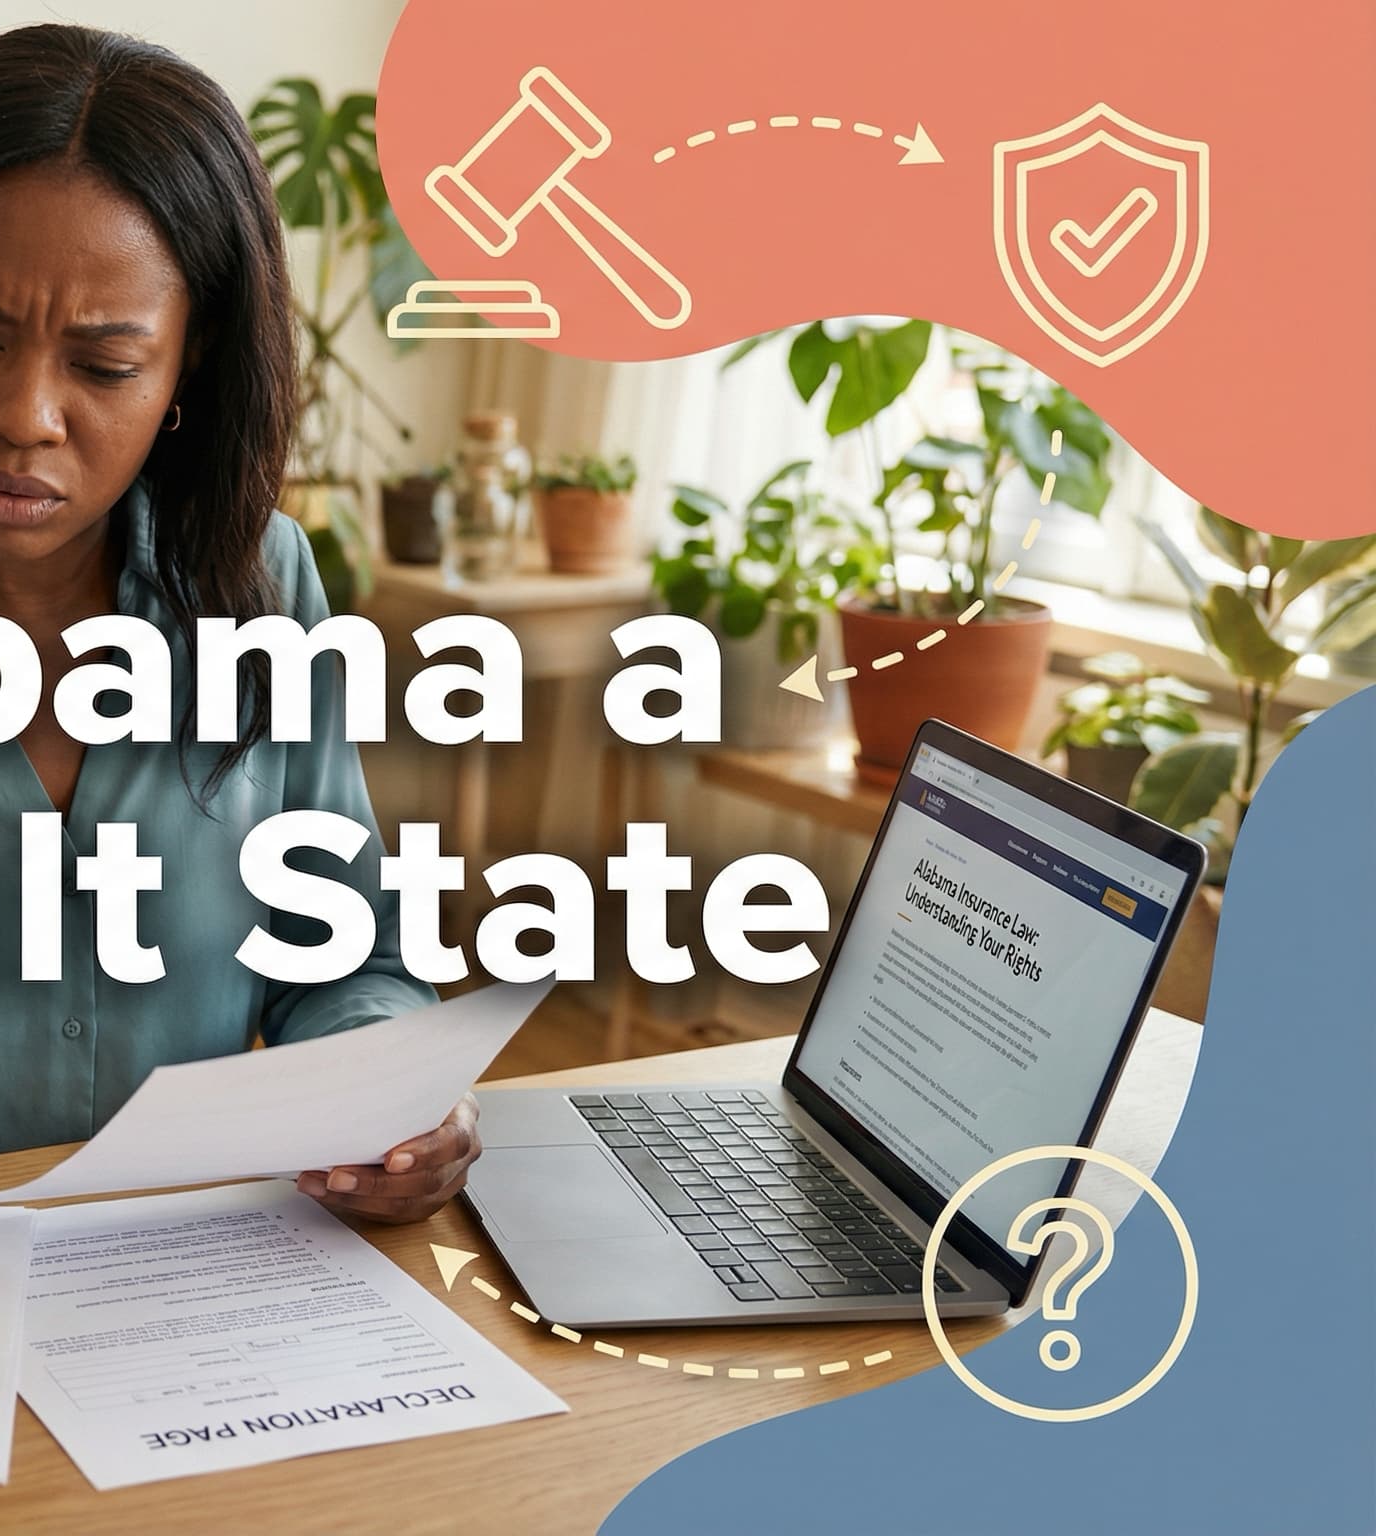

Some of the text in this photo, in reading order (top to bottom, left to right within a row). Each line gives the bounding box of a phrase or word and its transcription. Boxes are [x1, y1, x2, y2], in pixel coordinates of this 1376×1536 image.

[905, 881, 1043, 983] Understanding Your Rights
[913, 857, 958, 898] Alabama
[957, 882, 1011, 930] Insurance
[1010, 913, 1040, 947] Law:
[139, 1414, 239, 1451] PAGE
[241, 1383, 478, 1436] DECLARATION
